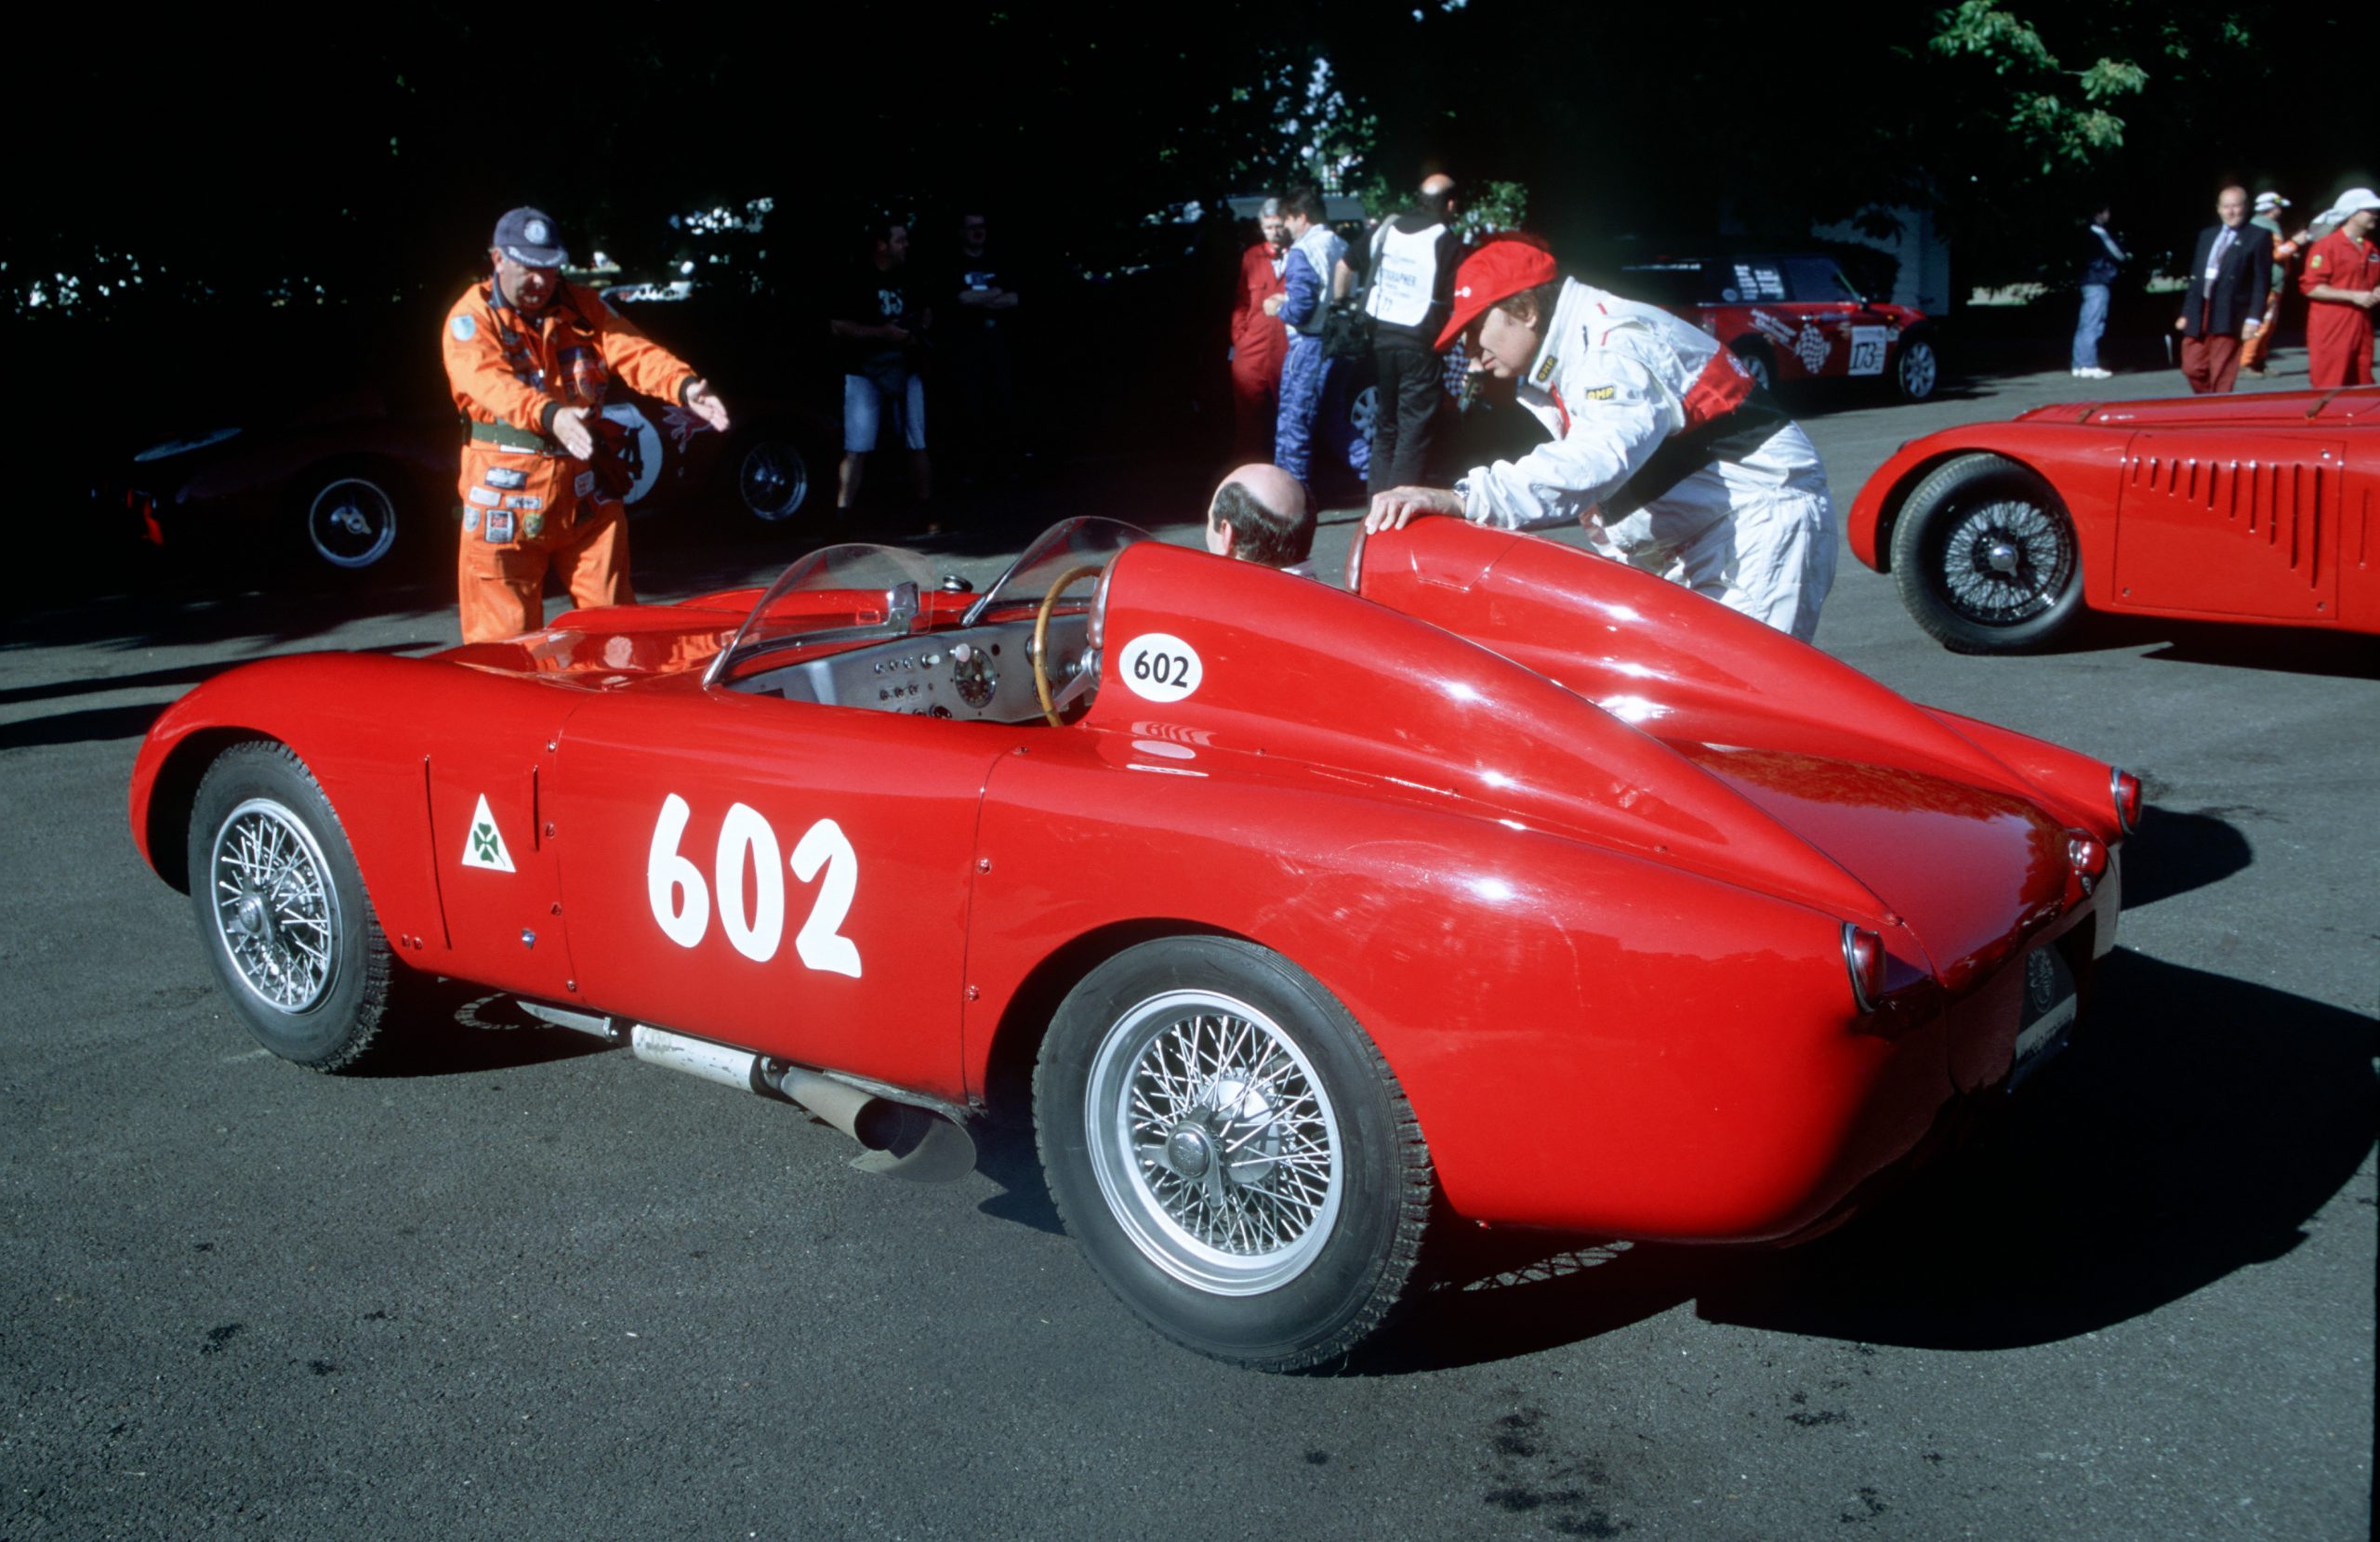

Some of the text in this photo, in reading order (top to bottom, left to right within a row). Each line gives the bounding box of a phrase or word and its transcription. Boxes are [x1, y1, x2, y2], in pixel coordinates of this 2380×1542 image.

[1538, 356, 1555, 381] OMP
[1849, 341, 1877, 370] 173
[1587, 387, 1614, 401] OMP
[1133, 650, 1189, 689] 602
[648, 792, 863, 979] 602
